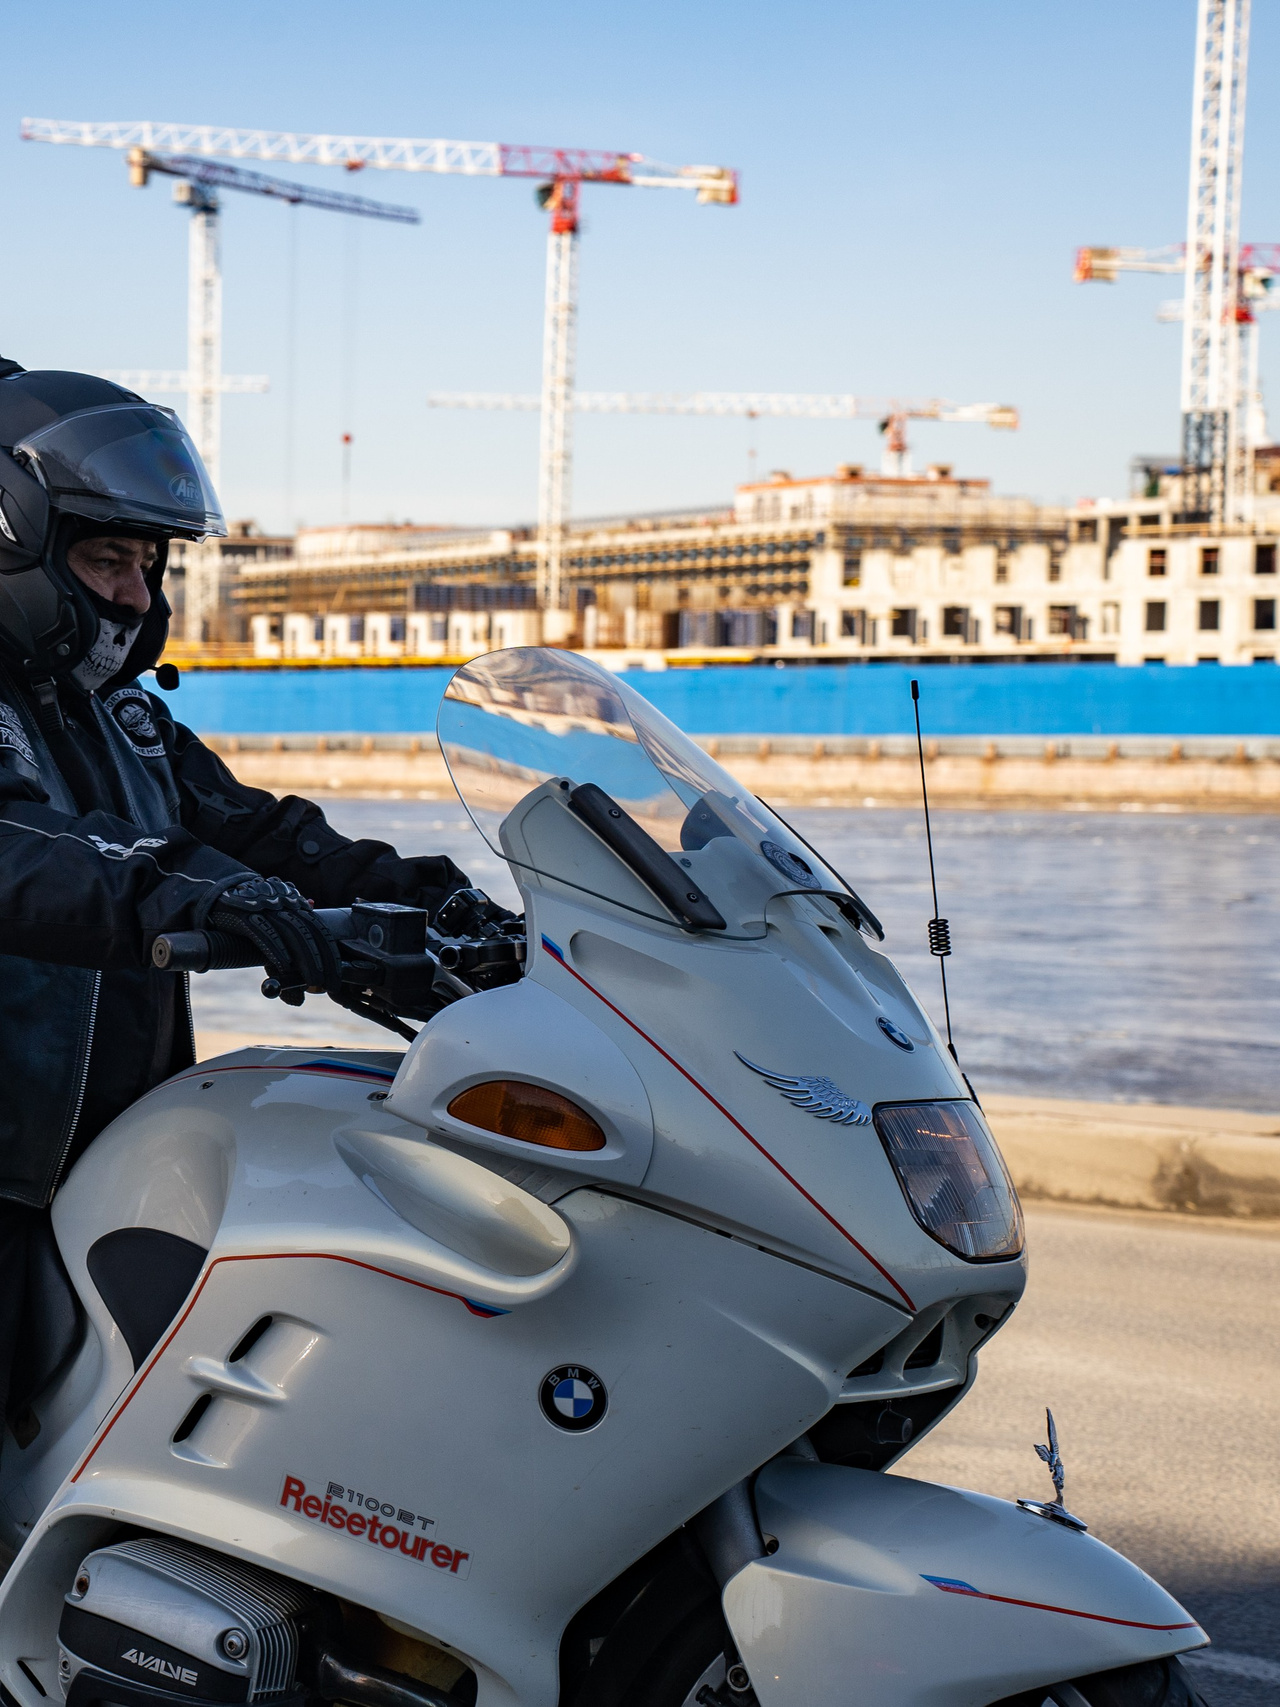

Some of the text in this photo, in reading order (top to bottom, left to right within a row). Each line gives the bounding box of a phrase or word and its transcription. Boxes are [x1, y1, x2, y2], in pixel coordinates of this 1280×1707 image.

[548, 1368, 600, 1390] BMW
[279, 1474, 469, 1574] Reisetourer
[120, 1648, 199, 1686] 4VALVE
